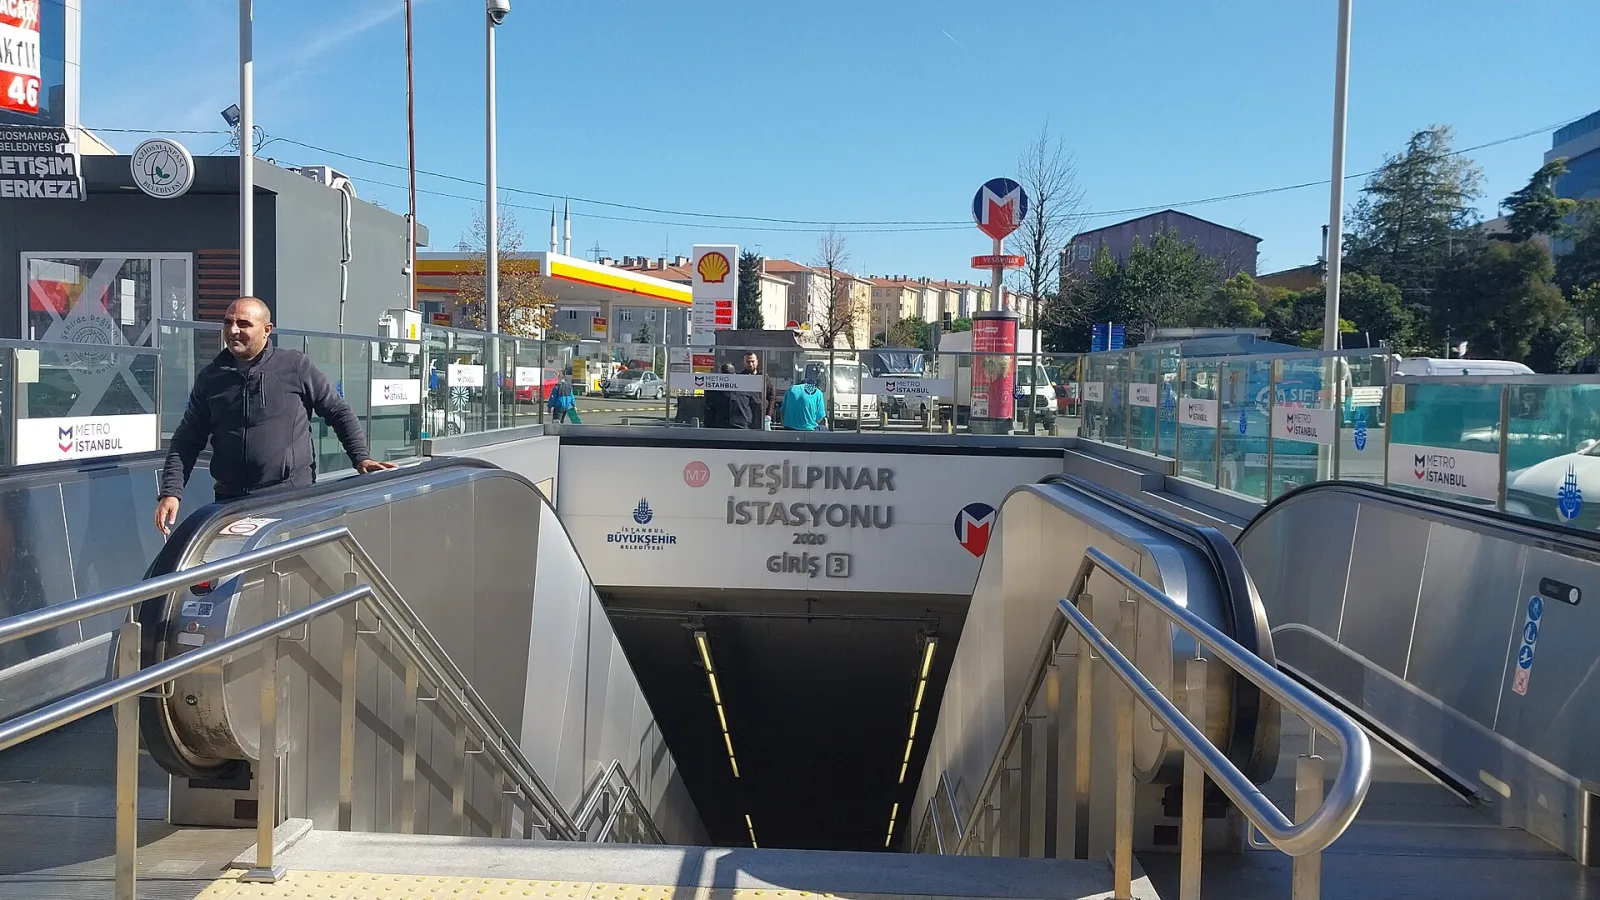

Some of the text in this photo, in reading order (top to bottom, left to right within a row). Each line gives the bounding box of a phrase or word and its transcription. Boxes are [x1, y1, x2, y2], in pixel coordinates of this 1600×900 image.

[7, 75, 38, 107] 46
[0, 142, 53, 152] BELEDİYESİ
[0, 156, 74, 178] ETİŞİM
[0, 179, 78, 199] ERKEZİ
[142, 181, 182, 193] BELEDİYESİ
[1294, 413, 1311, 424] METRO
[75, 422, 111, 436] METRO
[1293, 424, 1318, 438] İSTANBUL
[75, 438, 123, 453] İSTANBUL
[1426, 454, 1456, 469] METRO
[686, 460, 896, 495] M7 YEŞİLPINAR
[1426, 468, 1467, 488] İSTANBUL
[726, 496, 893, 529] İSTASYONU
[621, 526, 664, 534] İSTANBUL
[607, 532, 677, 546] BÜYÜKŞEHİR
[792, 533, 826, 545] 2020
[766, 552, 845, 578] GİRİŞ 3
